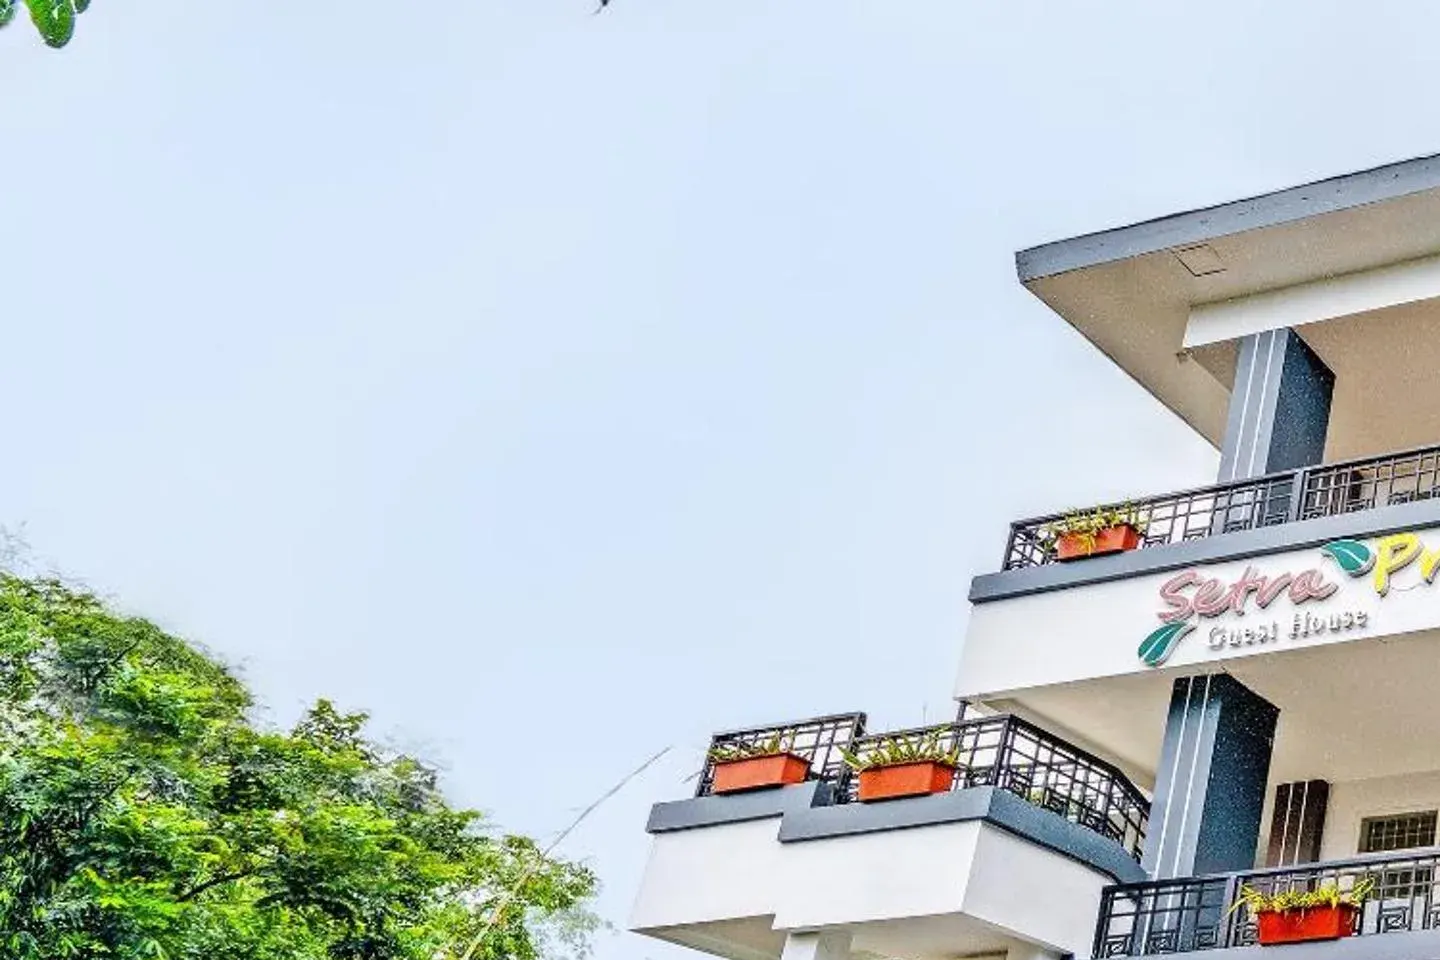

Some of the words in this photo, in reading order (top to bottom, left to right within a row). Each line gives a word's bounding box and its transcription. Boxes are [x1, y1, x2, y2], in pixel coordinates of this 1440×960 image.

[1158, 566, 1339, 620] Setra
[1208, 622, 1279, 651] Guest
[1289, 611, 1369, 641] House
